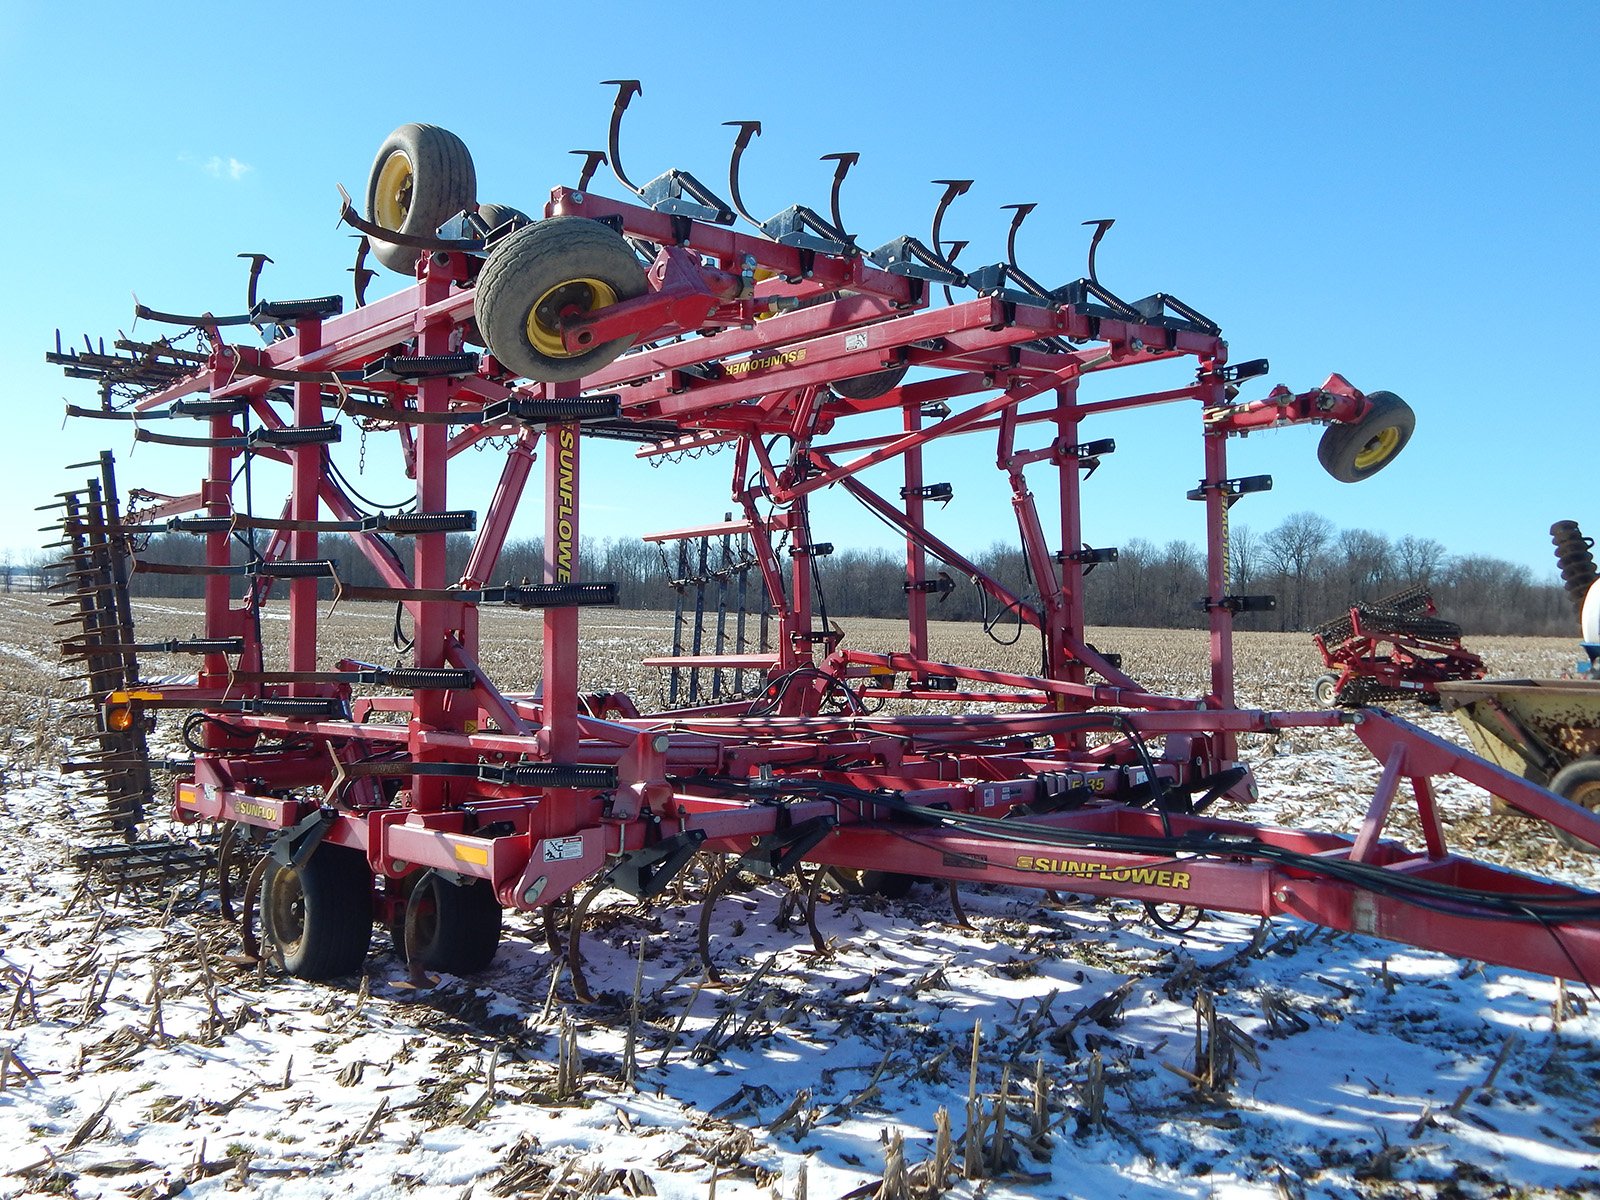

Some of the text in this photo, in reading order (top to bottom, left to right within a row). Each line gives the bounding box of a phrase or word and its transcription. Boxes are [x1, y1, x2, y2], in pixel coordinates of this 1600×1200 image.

[725, 350, 798, 376] SUNFLOWER
[558, 429, 574, 584] SUNFLOWE
[1034, 857, 1191, 889] SUNFLOWER
